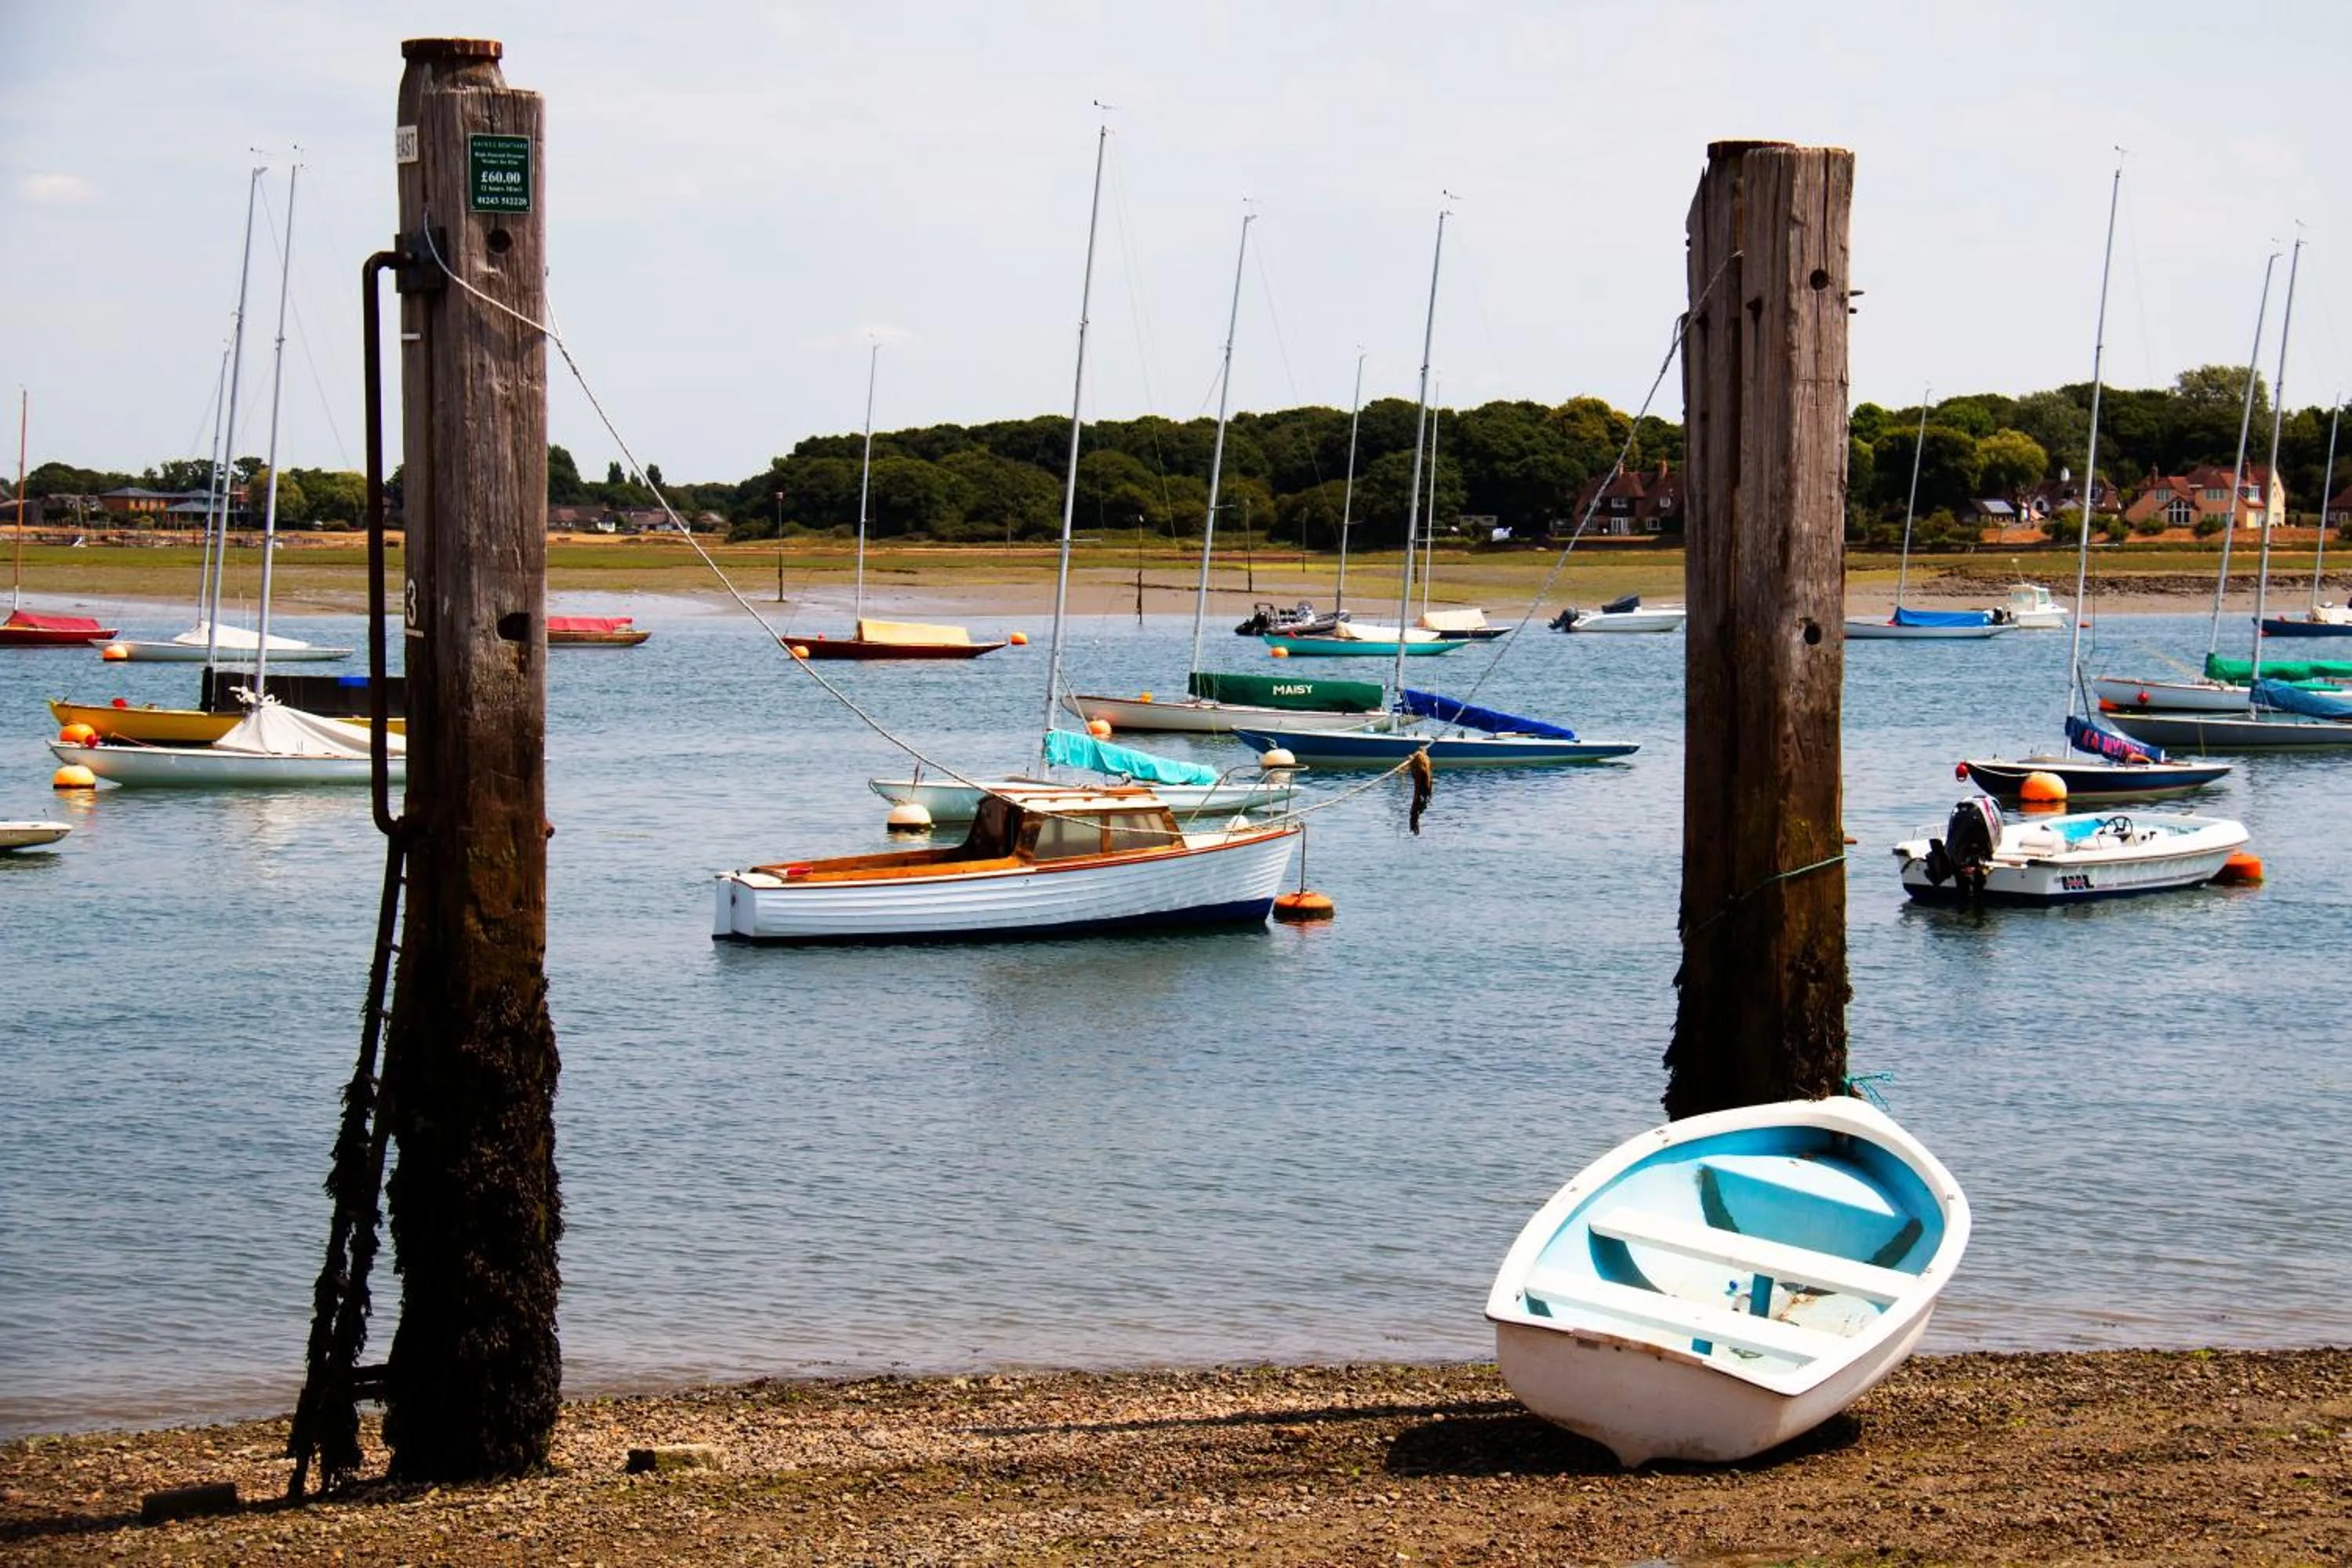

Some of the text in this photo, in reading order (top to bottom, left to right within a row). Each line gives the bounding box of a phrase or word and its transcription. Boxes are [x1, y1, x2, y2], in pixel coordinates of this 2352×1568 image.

[481, 171, 521, 184] £60.00
[407, 579, 416, 626] 3
[1272, 684, 1313, 695] MAISY
